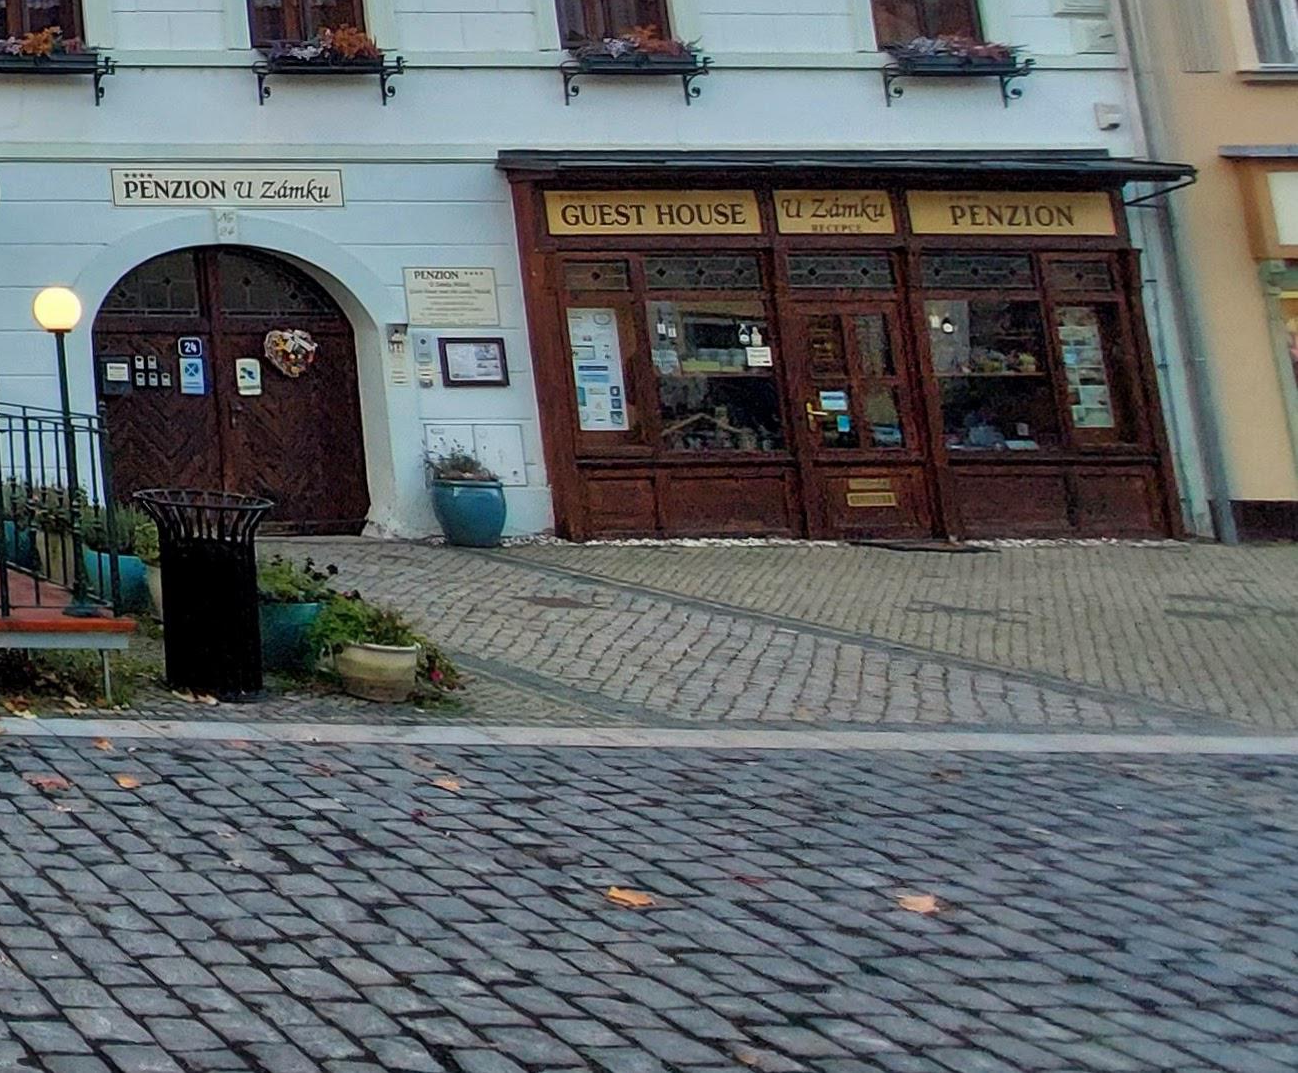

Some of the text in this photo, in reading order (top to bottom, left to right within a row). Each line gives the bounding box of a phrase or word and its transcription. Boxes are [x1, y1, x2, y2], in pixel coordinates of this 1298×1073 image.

[123, 178, 332, 203] PENZION U Zámku
[560, 202, 747, 227] GUEST HOUSE
[781, 194, 886, 223] U Zámku
[949, 204, 1075, 227] PENZION
[413, 270, 459, 280] PENZION
[184, 341, 198, 354] 24
